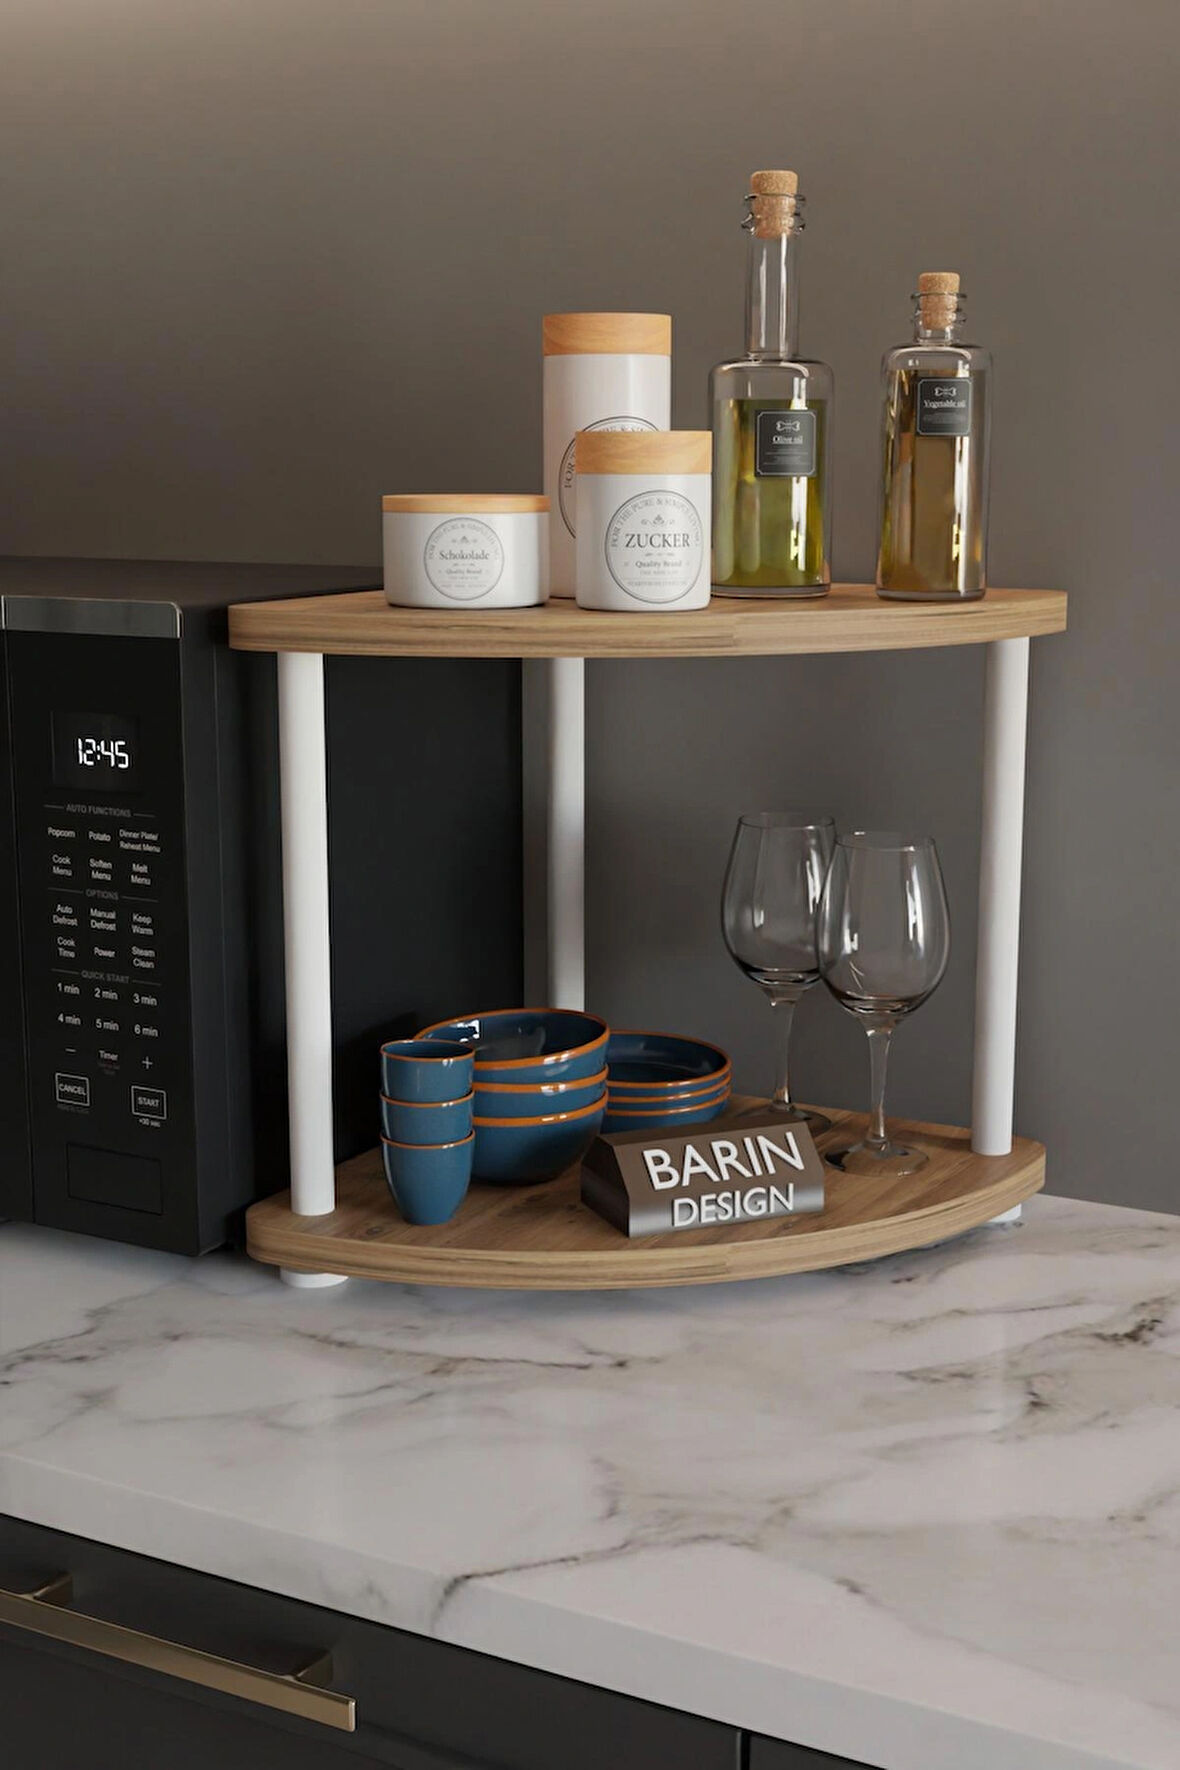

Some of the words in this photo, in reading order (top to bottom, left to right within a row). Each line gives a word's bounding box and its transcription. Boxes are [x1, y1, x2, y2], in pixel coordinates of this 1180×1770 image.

[773, 436, 792, 444] Olive
[625, 533, 690, 548] ZUCKER
[439, 549, 490, 560] Schokolade
[635, 560, 661, 569] Quality
[78, 738, 129, 769] 12:45
[66, 803, 86, 814] AUTO
[88, 805, 131, 817] FUNCTIONS
[47, 827, 75, 838] Popcorn
[89, 831, 111, 842] Potato
[119, 829, 139, 839] Dinner
[120, 840, 141, 851] Reheat
[143, 843, 161, 853] Menu
[52, 854, 71, 865] Cook
[90, 858, 112, 870] Soften
[52, 866, 72, 876] Menu
[132, 863, 148, 873] Melt
[91, 870, 111, 881] Menu
[131, 874, 151, 885] Menu
[85, 888, 118, 900] OPTIONS
[56, 904, 73, 914] Auto
[90, 908, 116, 919] Manual
[53, 915, 78, 926] Defrost
[132, 913, 152, 925] Keep
[90, 920, 116, 931] Defrost
[131, 924, 154, 935] Warm
[57, 936, 76, 947] Cook
[58, 948, 75, 958] Time
[94, 947, 115, 958] Power
[131, 946, 155, 957] Steam
[133, 958, 155, 969] Clean
[81, 970, 104, 981] QUICK
[106, 973, 130, 984] START
[57, 982, 63, 992] 1
[64, 984, 80, 995] min
[94, 987, 101, 998] 2
[102, 989, 118, 1000] min
[133, 993, 140, 1004] 3
[141, 995, 158, 1006] min
[57, 1013, 64, 1023] 4
[65, 1015, 81, 1025] min
[95, 1019, 102, 1029] 5
[103, 1020, 119, 1031] min
[134, 1024, 141, 1034] 6
[142, 1026, 159, 1037] min
[99, 1050, 119, 1061] Timer
[59, 1083, 86, 1096] CANCEL
[138, 1096, 159, 1107] START
[643, 1131, 805, 1191] BARIN
[672, 1183, 795, 1228] DESIGN
